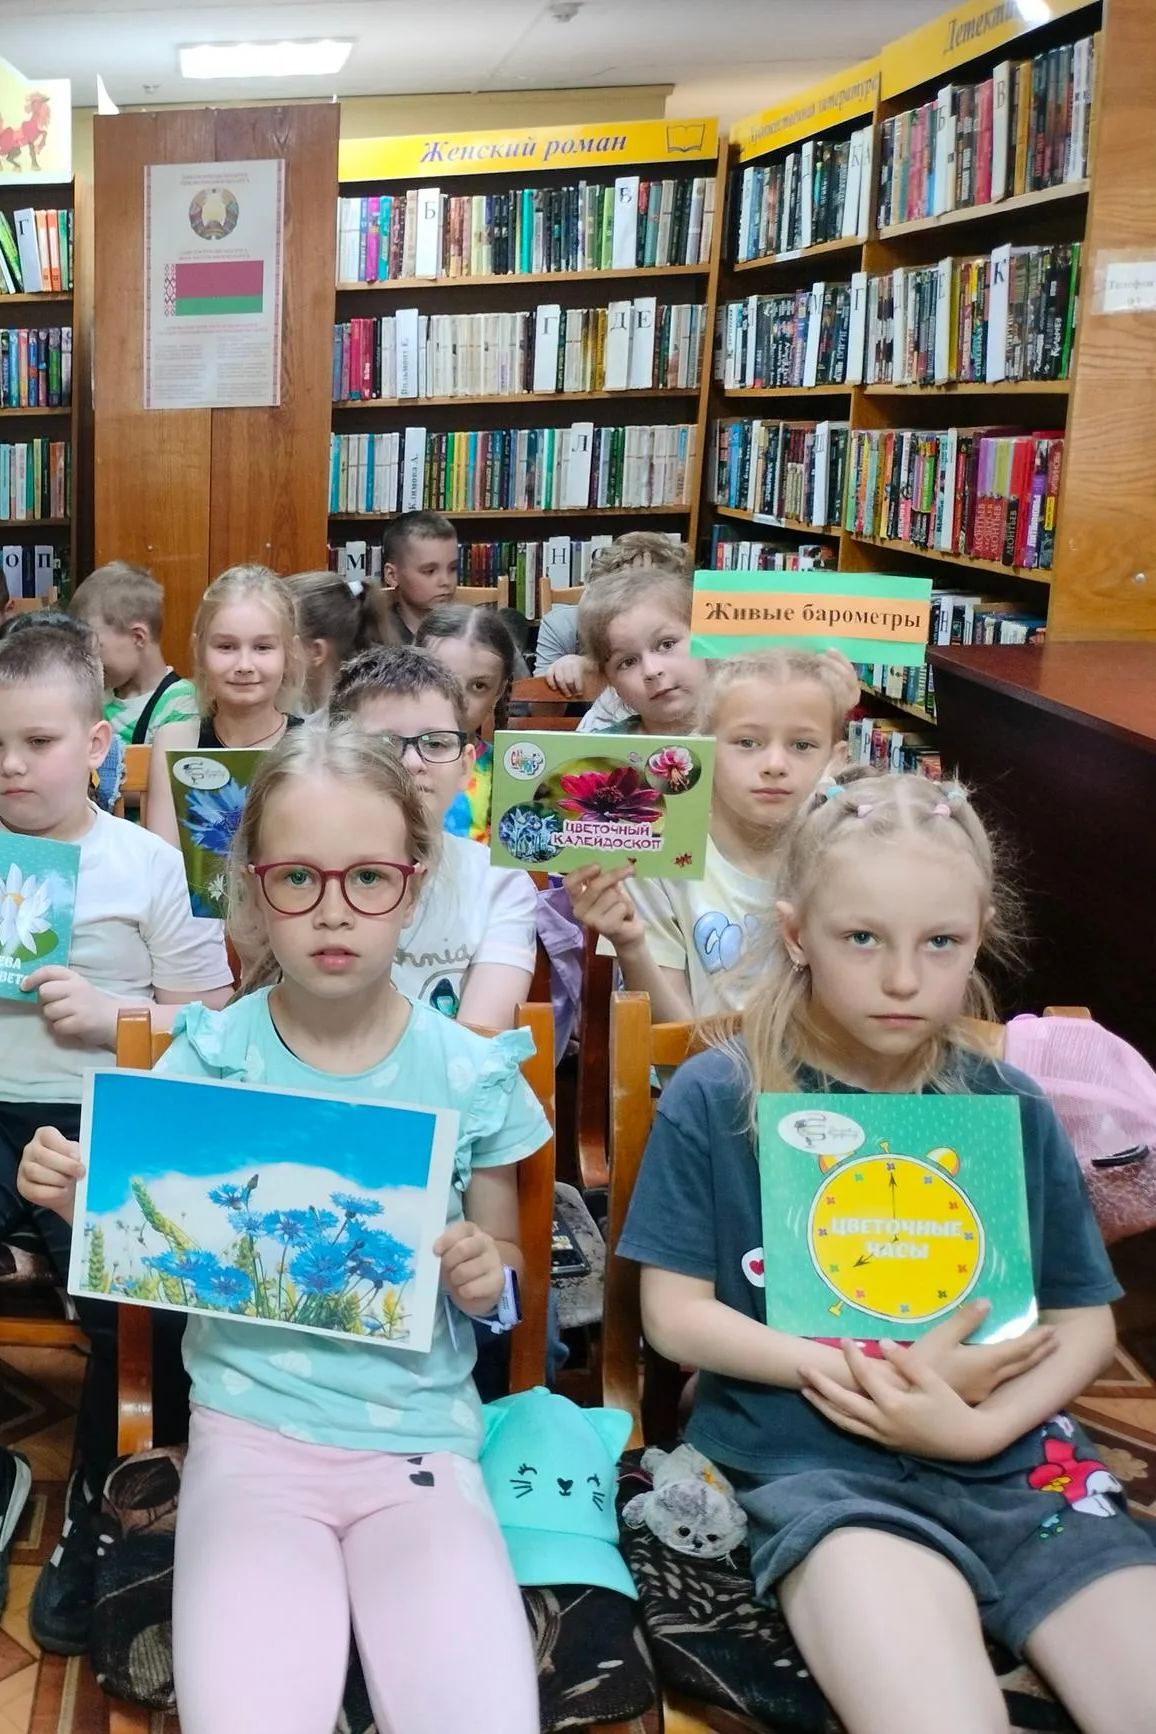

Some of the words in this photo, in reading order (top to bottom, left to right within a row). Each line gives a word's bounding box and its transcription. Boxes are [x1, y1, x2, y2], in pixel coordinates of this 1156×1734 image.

[419, 136, 536, 164] Женский
[543, 135, 627, 162] роман
[424, 202, 436, 220] Б
[17, 218, 29, 236] Г
[993, 259, 1006, 285] К
[543, 315, 558, 334] Г
[610, 311, 627, 331] Д
[637, 309, 652, 328] Е
[572, 434, 589, 451] Л
[5, 554, 19, 568] О
[38, 555, 51, 568] П
[347, 554, 365, 570] М
[552, 548, 566, 564] Н
[705, 602, 795, 621] Живые
[802, 604, 921, 631] барометры
[566, 822, 649, 836] ЦВЕТОЧНЫЙ
[553, 833, 661, 850] КАЛЕЙДОСКОП
[831, 1217, 962, 1237] ЦВЕТОЧНЫЕ
[866, 1241, 929, 1260] ЧАСЫ
